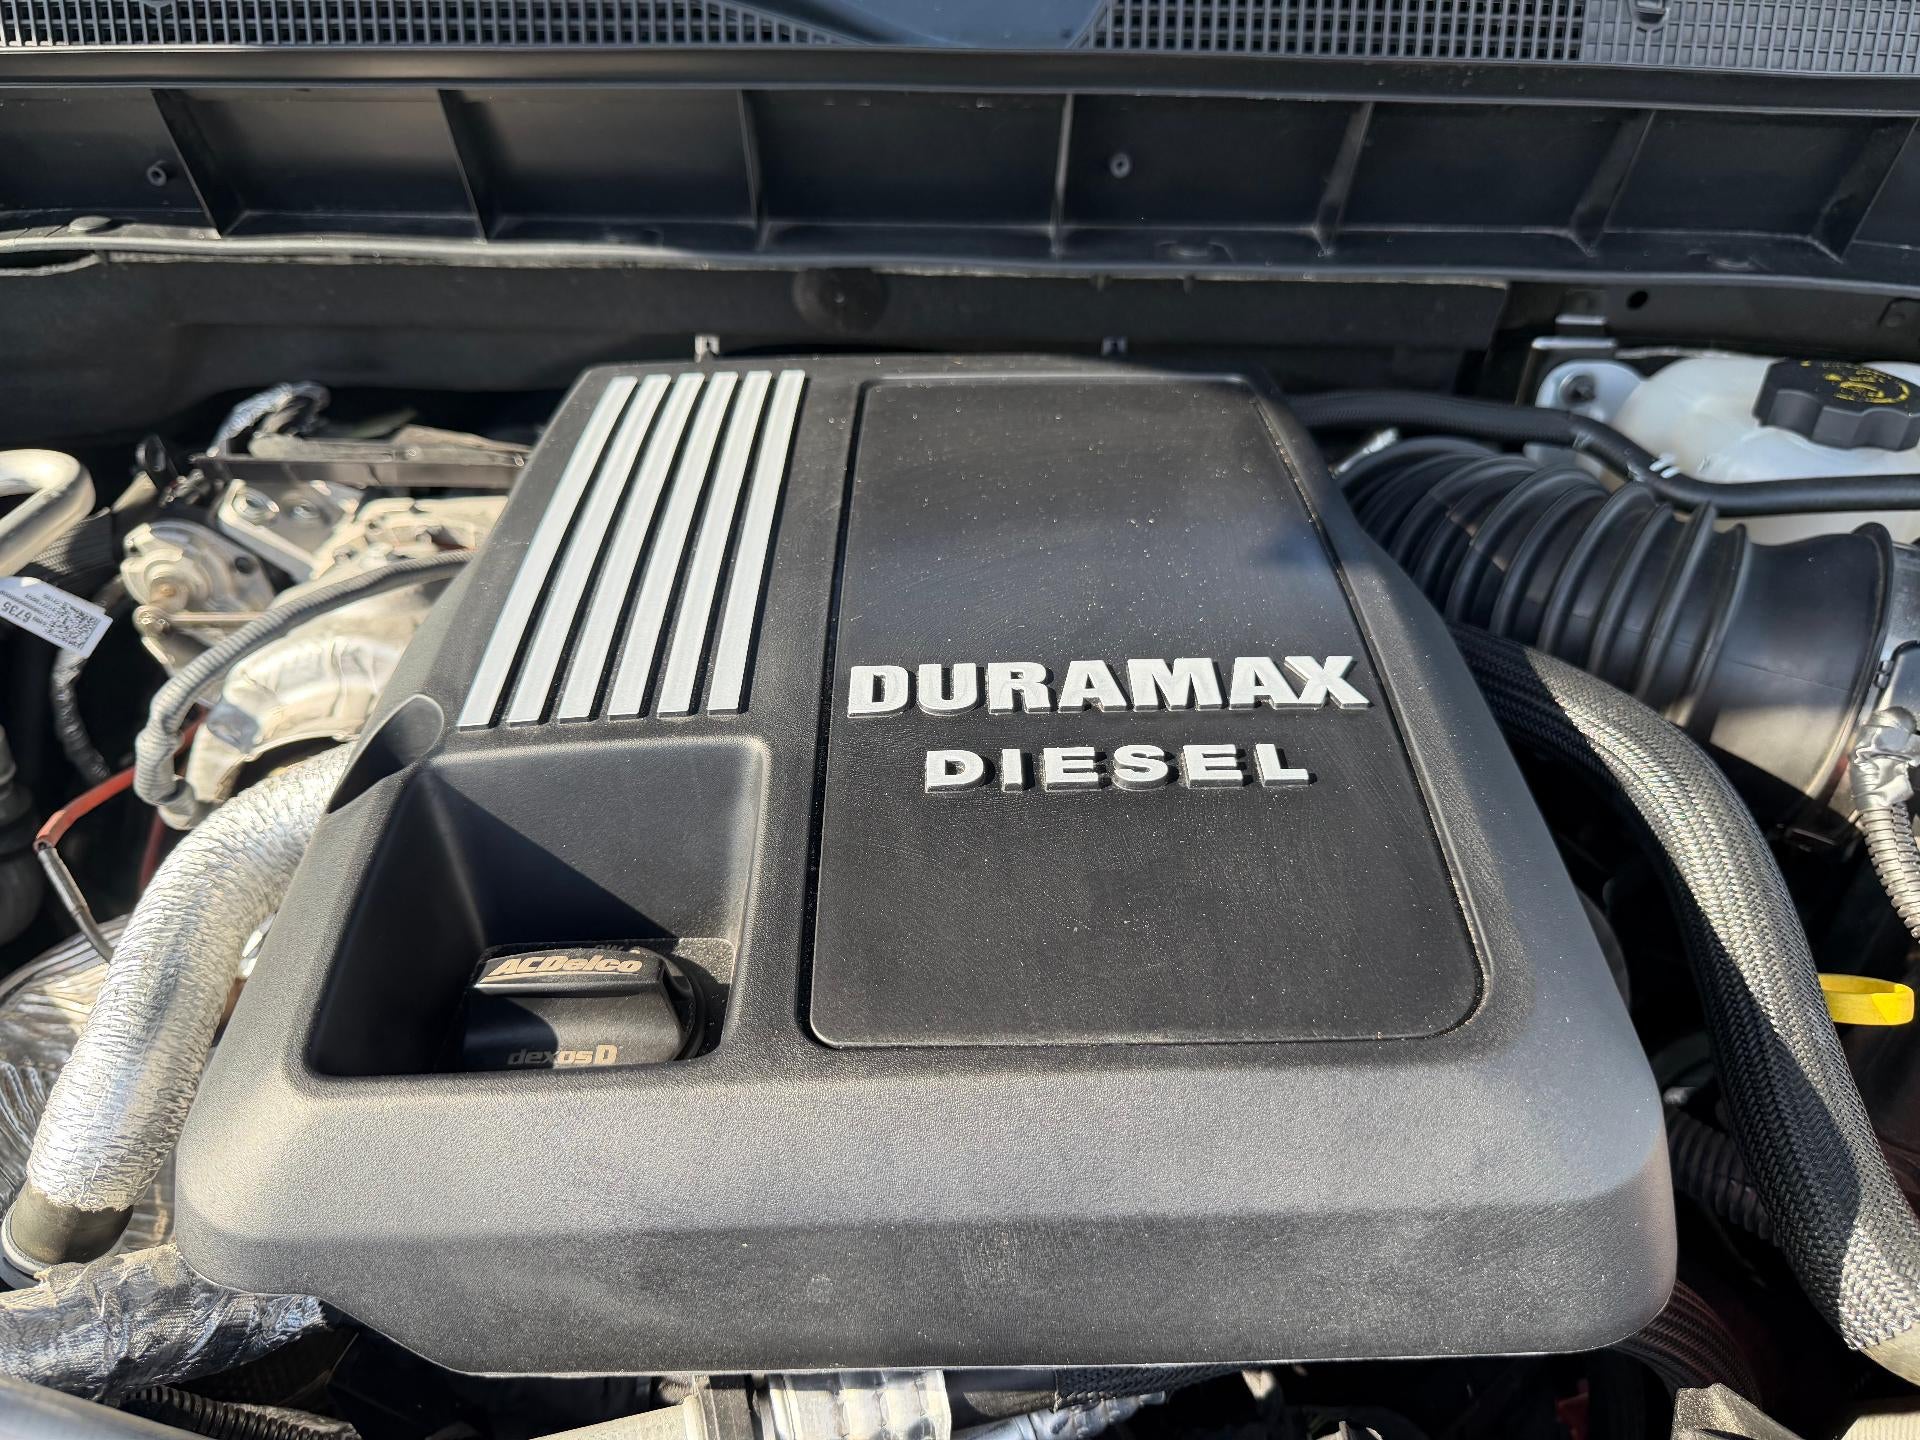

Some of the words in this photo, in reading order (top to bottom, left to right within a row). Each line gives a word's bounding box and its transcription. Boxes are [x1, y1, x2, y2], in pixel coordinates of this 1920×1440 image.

[847, 655, 1371, 717] DURAMAX
[924, 743, 1311, 792] DIESEL
[489, 954, 643, 977] ACDelco
